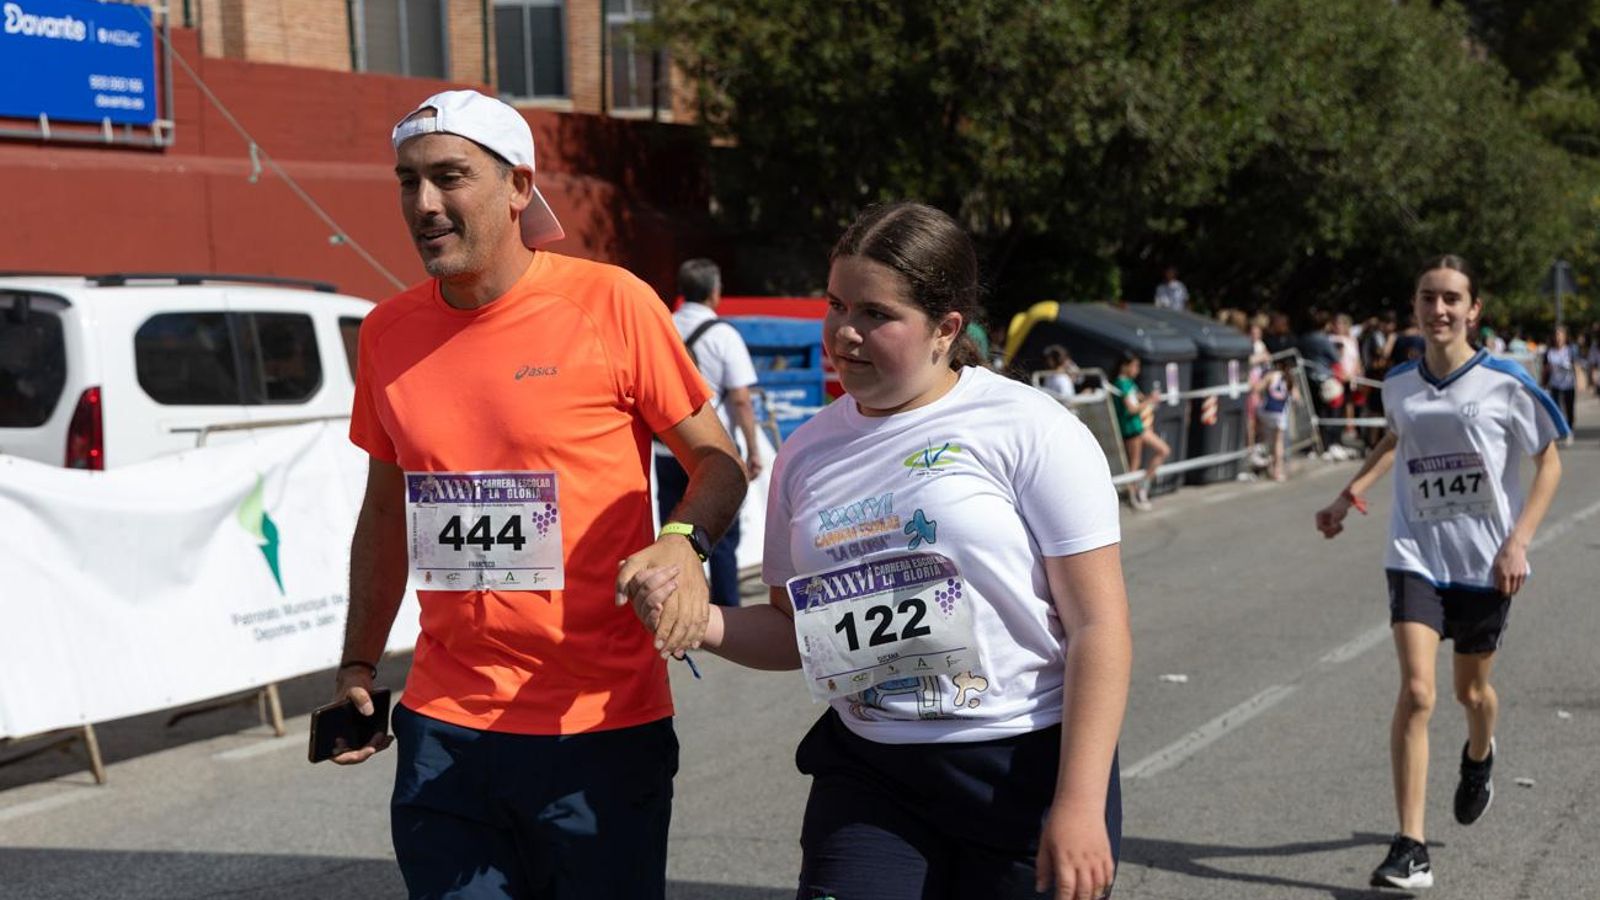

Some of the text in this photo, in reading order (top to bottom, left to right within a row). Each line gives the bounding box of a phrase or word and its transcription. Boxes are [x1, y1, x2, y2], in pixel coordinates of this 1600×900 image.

[4, 3, 86, 42] Davante
[481, 477, 551, 488] CARRERA ESCOLAR
[489, 488, 541, 499] LA GLORIA
[1419, 472, 1482, 500] 1147
[818, 493, 895, 532] XXXVI
[438, 515, 526, 551] 444
[820, 563, 875, 600] XXXVI
[874, 560, 912, 578] CARRERA
[882, 565, 941, 587] LA GLORIA
[835, 598, 931, 652] 122
